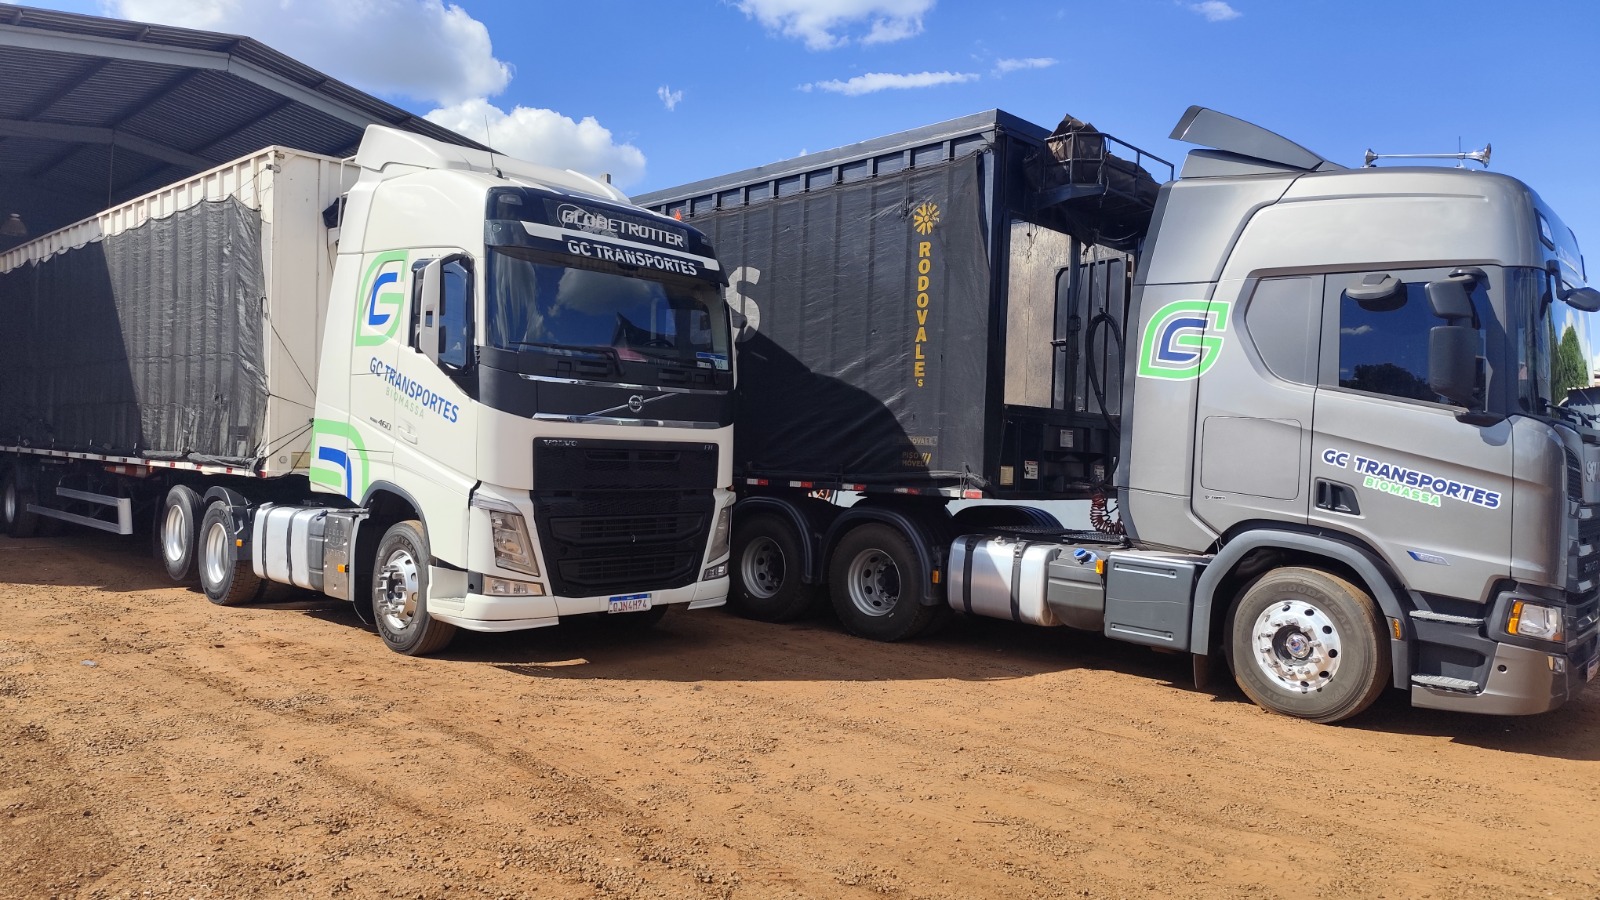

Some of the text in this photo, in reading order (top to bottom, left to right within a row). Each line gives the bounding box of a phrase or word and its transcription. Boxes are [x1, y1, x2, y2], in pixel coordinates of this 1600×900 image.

[562, 209, 684, 248] GLOBETROTTER
[567, 240, 698, 276] GC TRANSPORTES
[370, 357, 459, 423] GC TRANSPORTES
[385, 386, 424, 419] BIOMASSA
[1323, 449, 1500, 509] GC TRANSPORTES
[1364, 476, 1440, 506] BIOMASSA
